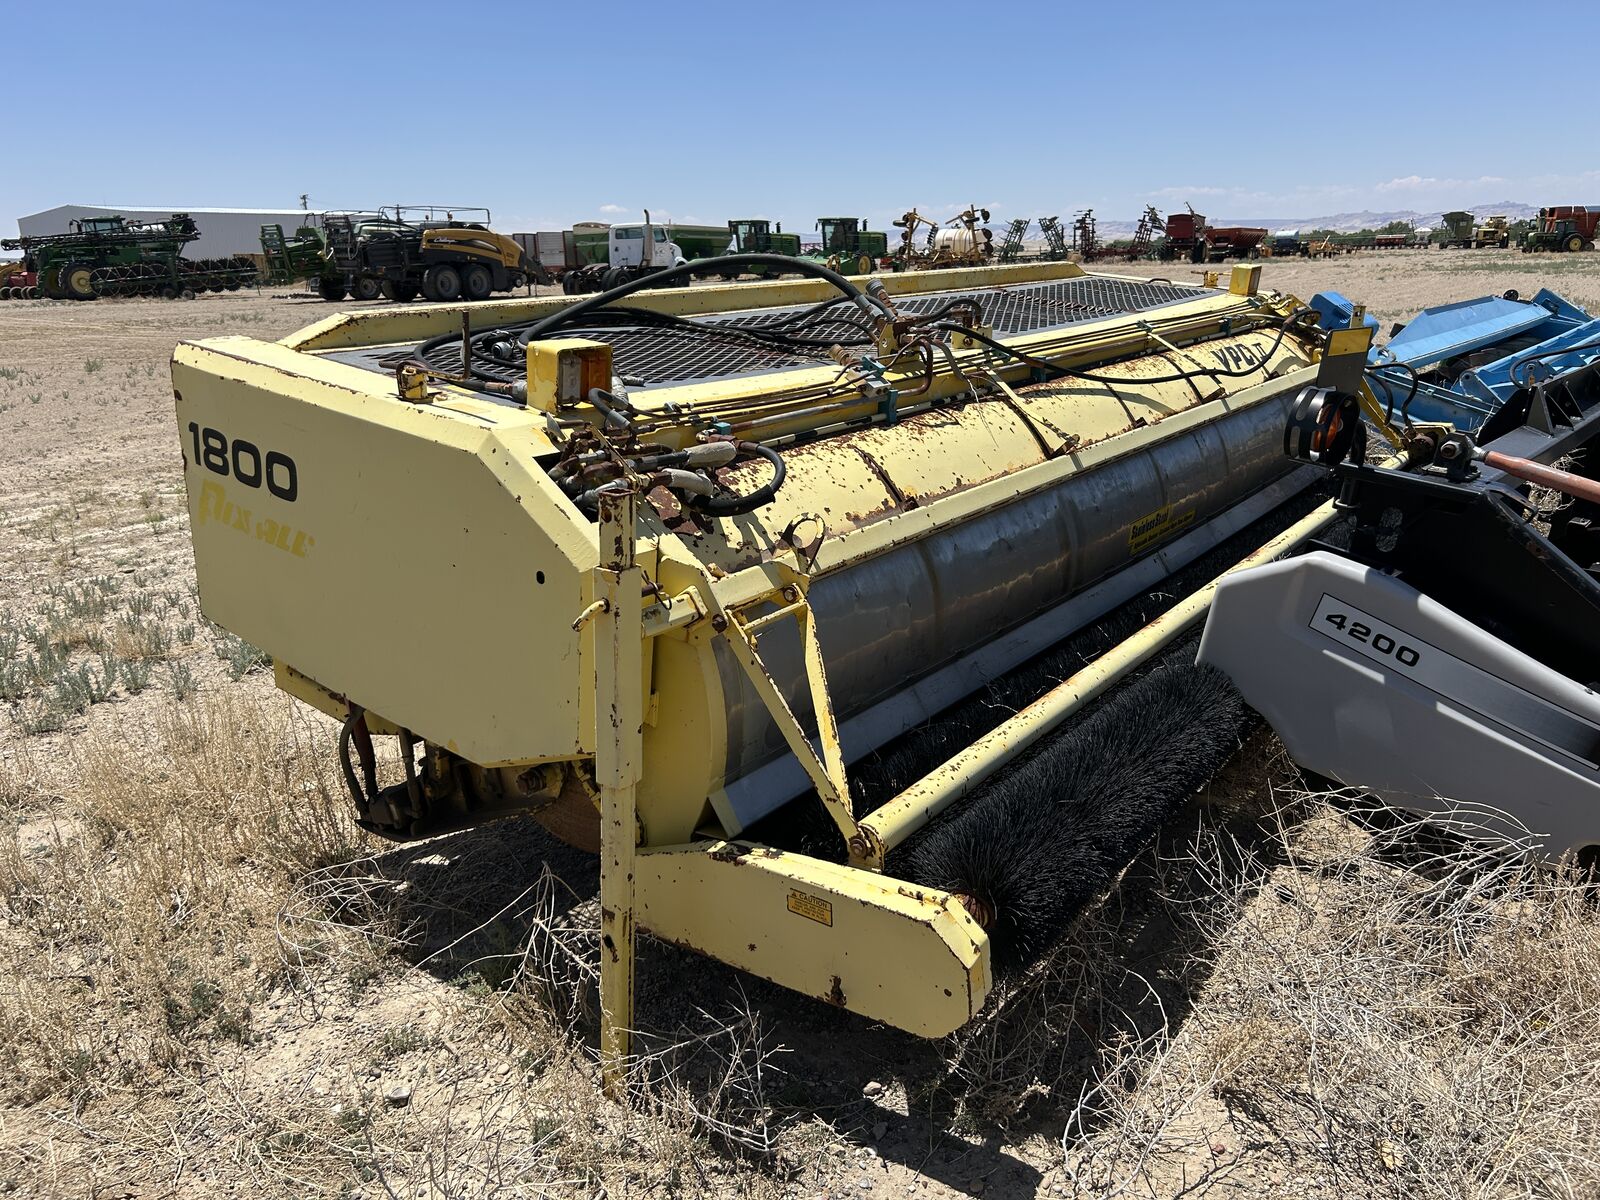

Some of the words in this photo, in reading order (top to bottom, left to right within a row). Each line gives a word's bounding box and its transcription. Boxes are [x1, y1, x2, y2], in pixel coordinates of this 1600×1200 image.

[188, 421, 298, 502] 1800
[1325, 613, 1420, 667] 4200
[798, 893, 828, 909] CAUTION
